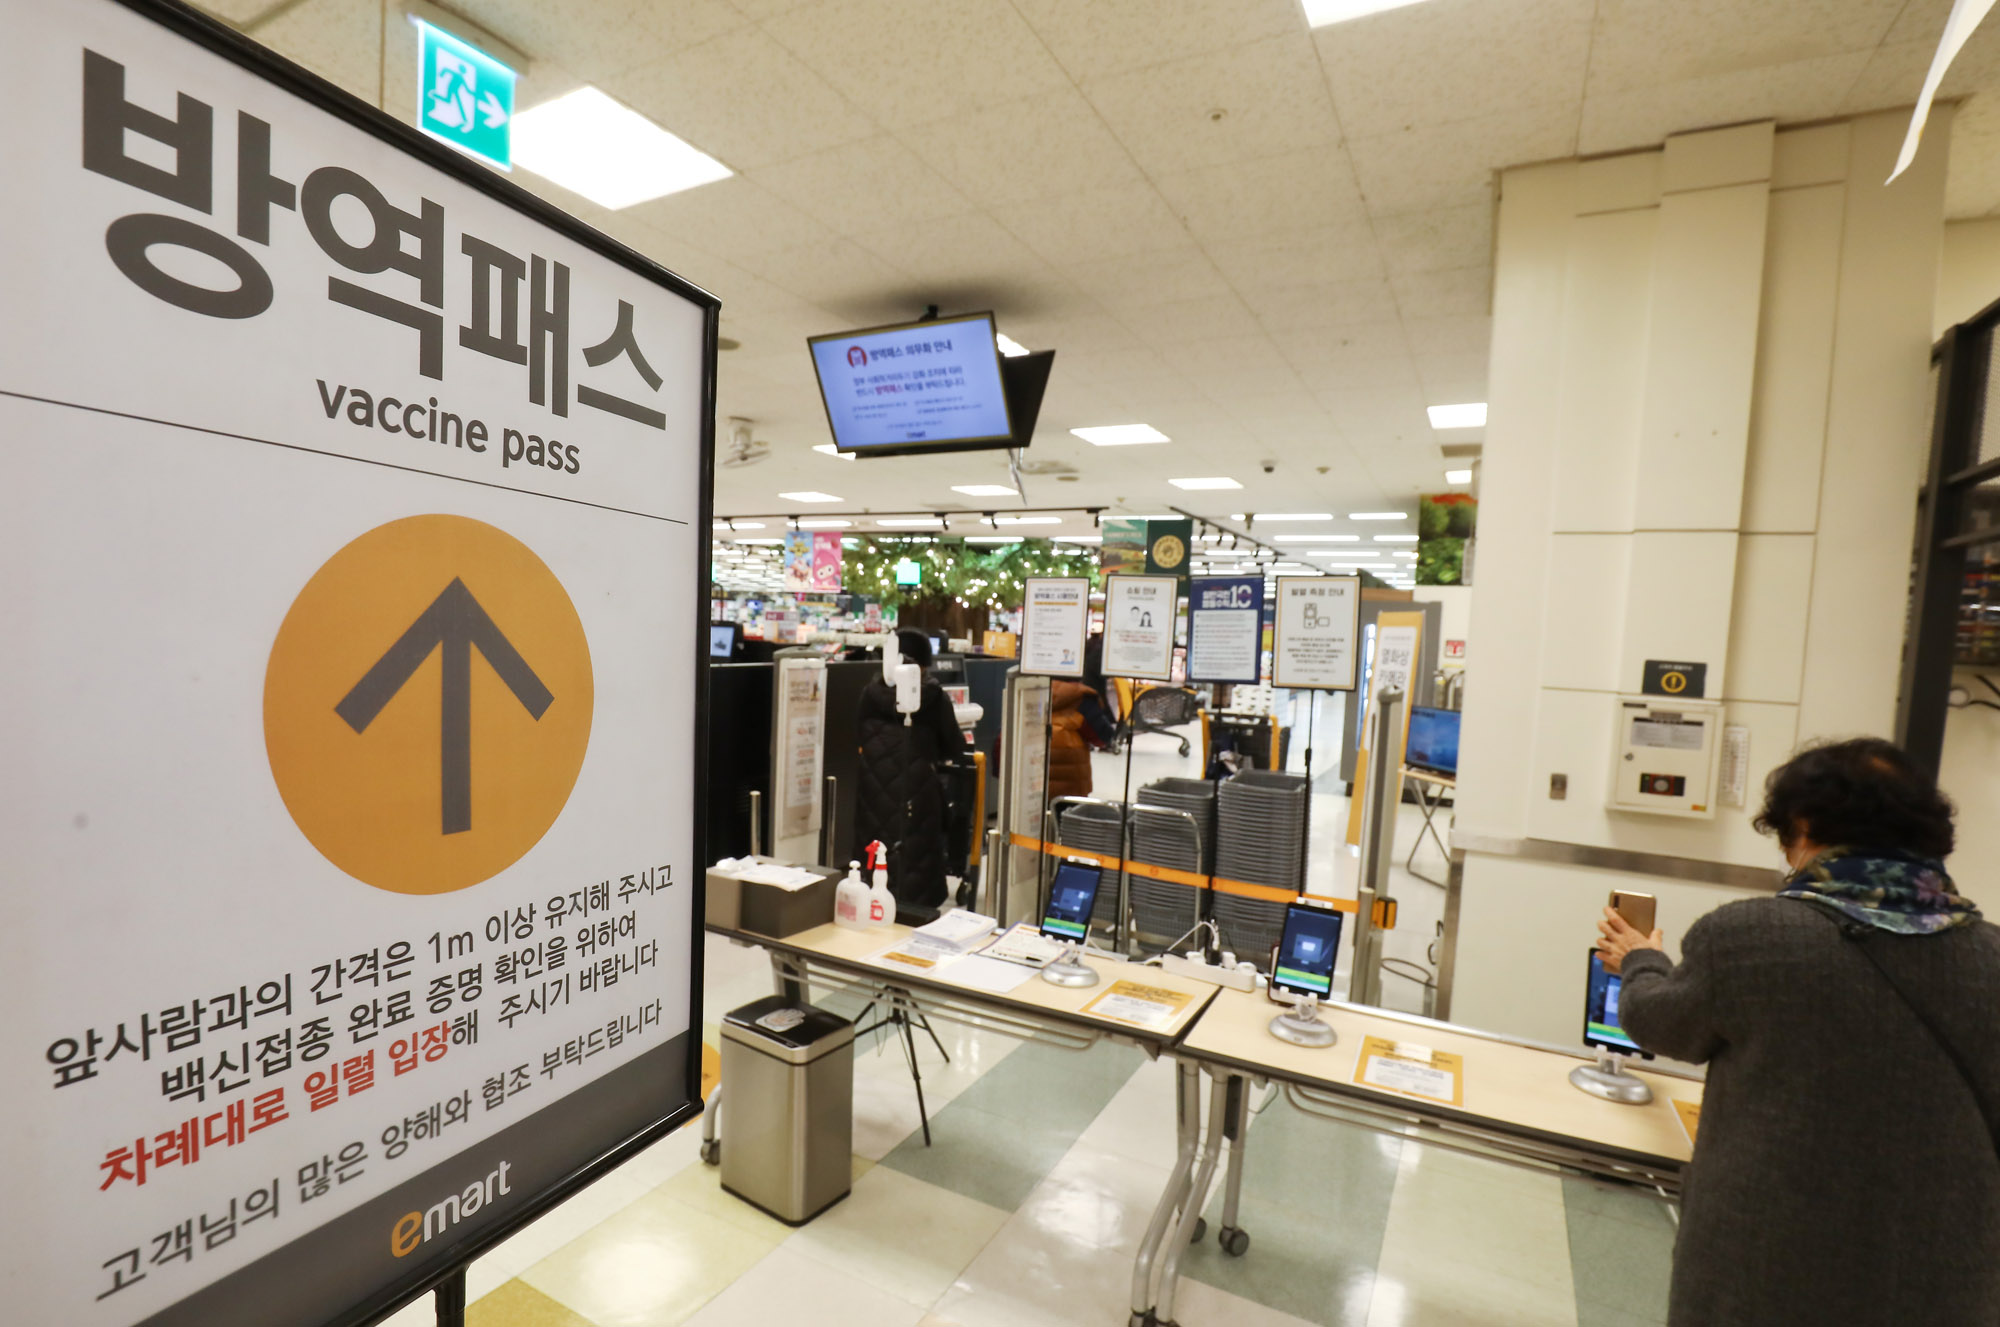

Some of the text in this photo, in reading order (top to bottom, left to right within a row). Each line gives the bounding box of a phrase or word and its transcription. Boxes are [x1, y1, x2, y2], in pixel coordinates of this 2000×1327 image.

[83, 47, 667, 431] 방역패스
[316, 379, 580, 475] vaccine pass
[45, 864, 674, 1090] 앞사람과의 간격은 1m 이상 유지해 주시고
[99, 938, 659, 1192] 차례대로 일렬 입장해 주시기 바랍니다
[161, 909, 636, 1104] 백신접종 완료 증명 확인을 위하여
[95, 998, 663, 1303] 고객님의 많은 양해와 협조 부탁드립니다
[391, 1160, 511, 1258] emart
